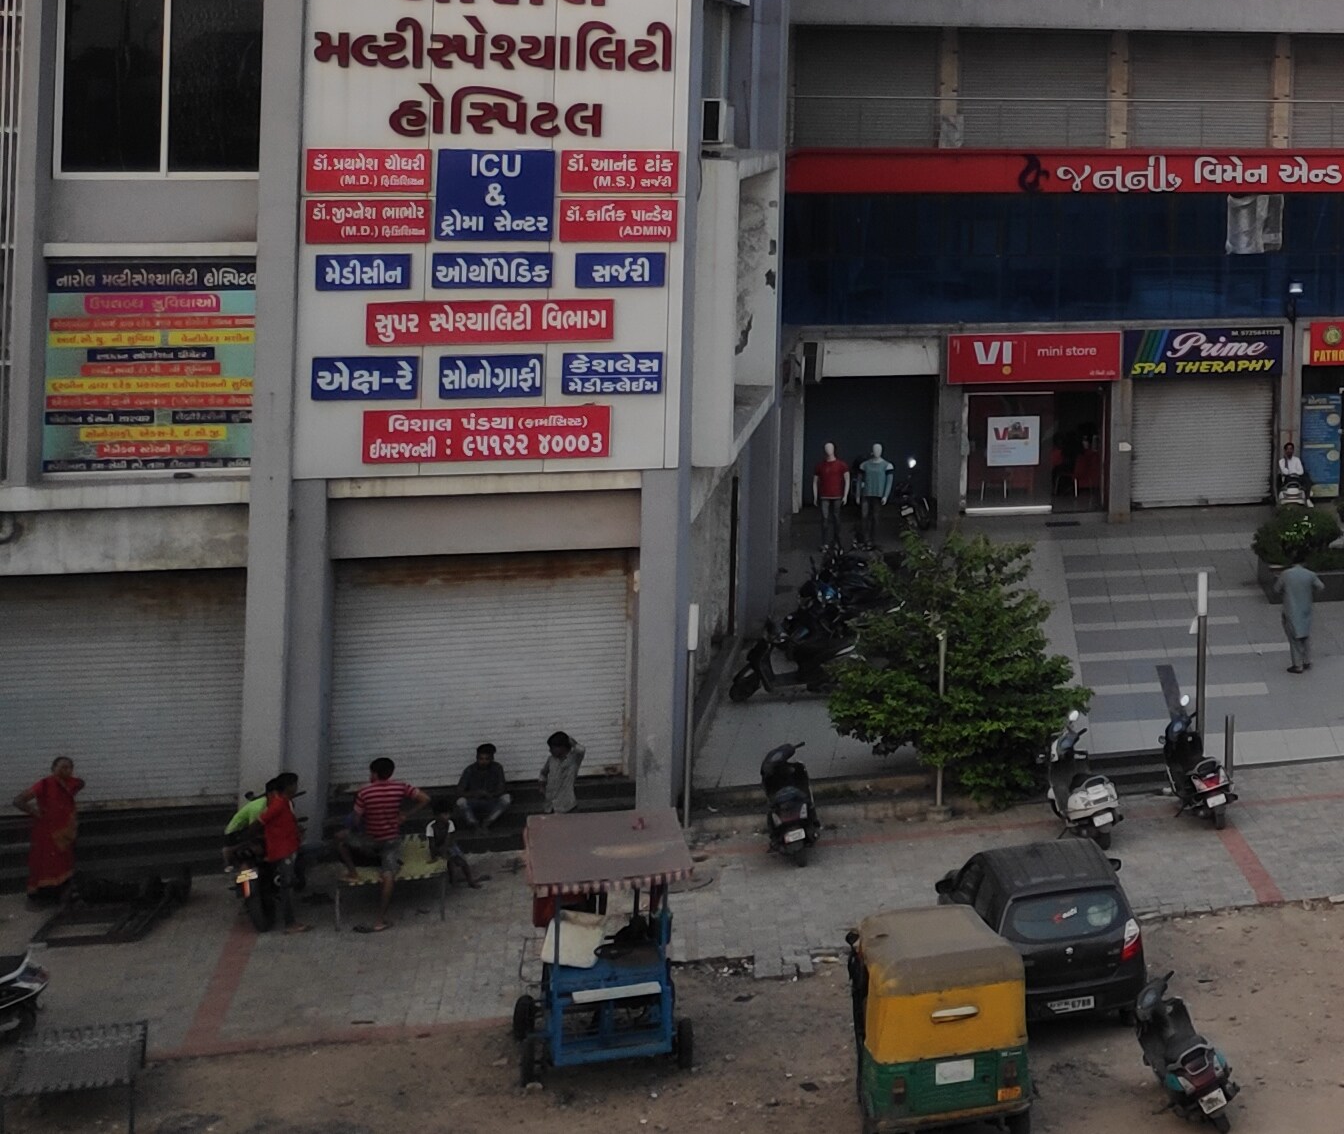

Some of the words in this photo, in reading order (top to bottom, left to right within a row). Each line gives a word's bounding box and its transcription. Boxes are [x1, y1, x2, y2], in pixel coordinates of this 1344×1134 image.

[314, 15, 672, 71] મલ્ટીસ્પેશ્યાલિટી
[389, 83, 603, 137] હોસ્પિટલ
[471, 154, 521, 177] ICU
[644, 154, 673, 172] ટાંક
[1194, 156, 1268, 184] વિમેન
[1279, 157, 1342, 184] એન્ડ
[340, 175, 377, 186] (M.D.)
[593, 176, 635, 189] (M.S.)
[484, 183, 506, 206] &
[382, 202, 424, 219] ભાભોર
[341, 226, 378, 237] (M.D.)
[440, 209, 483, 236] ટ્રોમા
[494, 213, 548, 232] સેન્ટર
[619, 226, 671, 237] (ADMIN)
[56, 270, 95, 287] નારોલ
[203, 268, 256, 286] હોસ્પિટલ
[325, 258, 402, 285] મેડીસીન
[593, 257, 650, 283] સર્જરી
[375, 313, 419, 342] સુપર
[429, 304, 532, 332] સ્પેશ્યાલિટી
[542, 303, 607, 329] વિભાગ
[1037, 346, 1063, 357] mini
[1066, 346, 1097, 356] store
[1166, 331, 1268, 358] Prime
[442, 354, 541, 393] સોનોગ્રાફી
[569, 354, 658, 374] કેશલેસ
[1131, 362, 1167, 375] SPA
[1175, 359, 1276, 374] THERAPHY
[388, 415, 451, 432] વિશાલ
